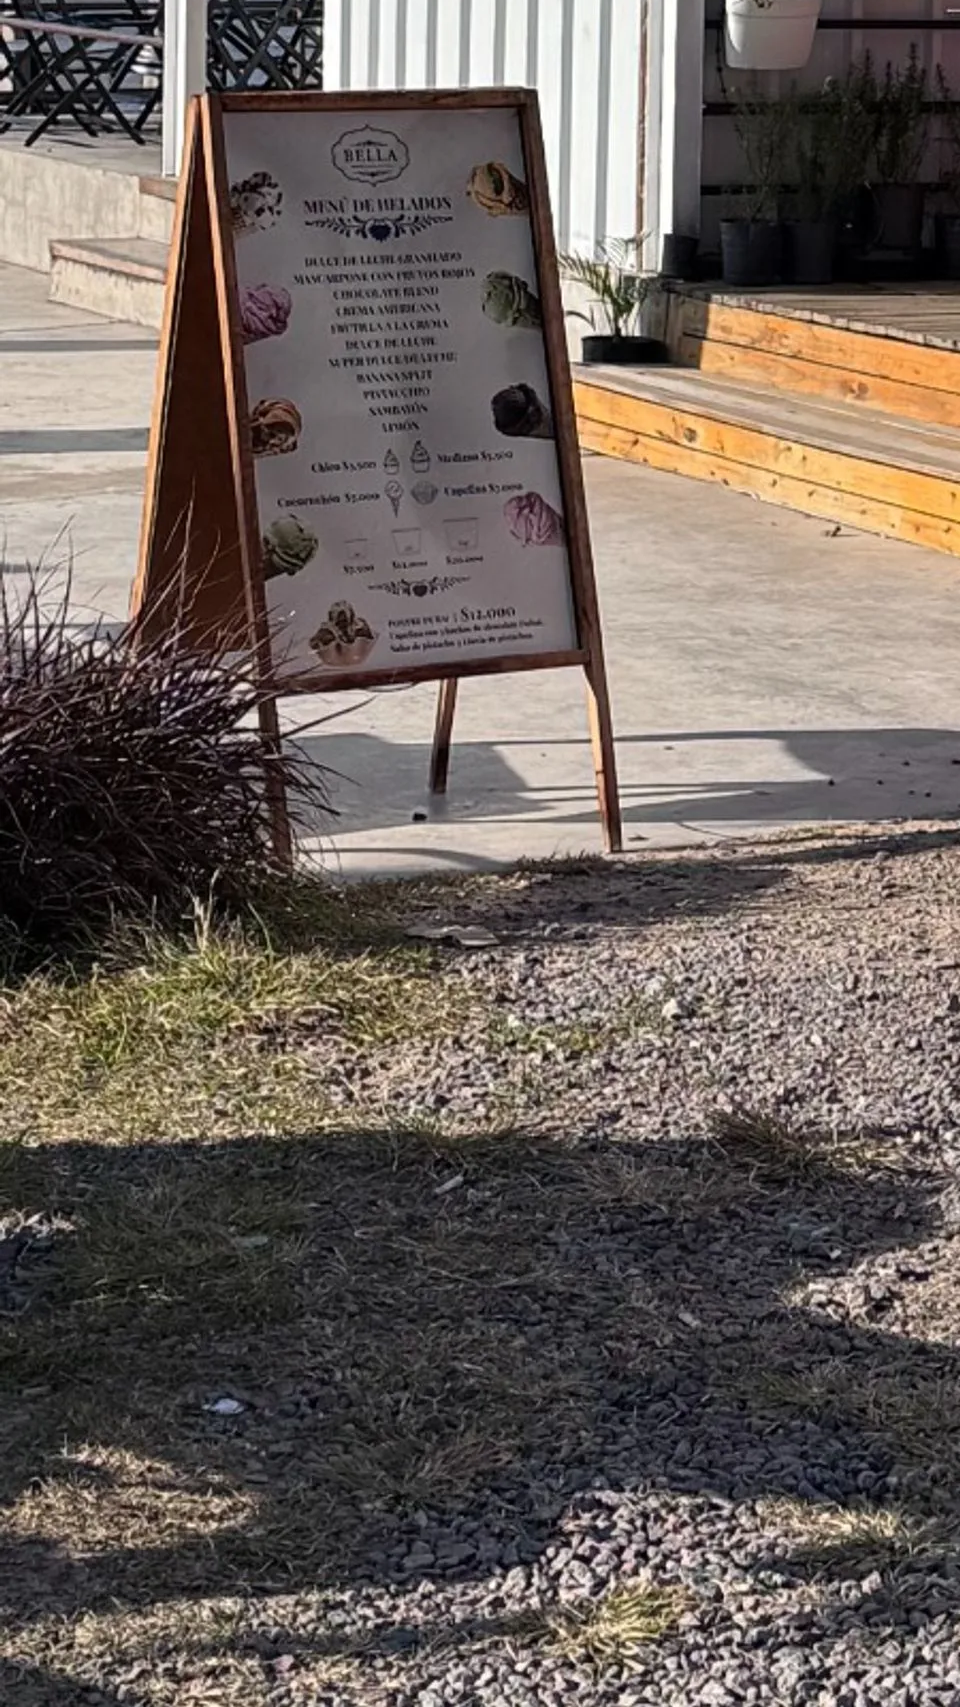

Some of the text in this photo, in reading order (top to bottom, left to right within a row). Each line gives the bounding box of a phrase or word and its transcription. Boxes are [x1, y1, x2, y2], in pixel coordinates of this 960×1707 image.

[343, 147, 398, 163] BELLA
[304, 196, 453, 215] MENÚ DE HELADOS
[304, 255, 342, 268] DULCE
[343, 254, 357, 267] DE
[360, 253, 397, 266] LECHE
[292, 267, 476, 286] MASCARPONE CON FRUTOS ROJOS
[332, 287, 401, 301] CHOCOLATE
[335, 302, 441, 318] CREMA AMERICANA
[330, 321, 381, 335] FRUTILLA
[394, 320, 409, 331] LA
[409, 318, 450, 331] CREMA
[345, 336, 436, 351] DULCE DE LECHE
[356, 369, 433, 384] BANANA SPLIT
[381, 419, 421, 434] LIMÓN
